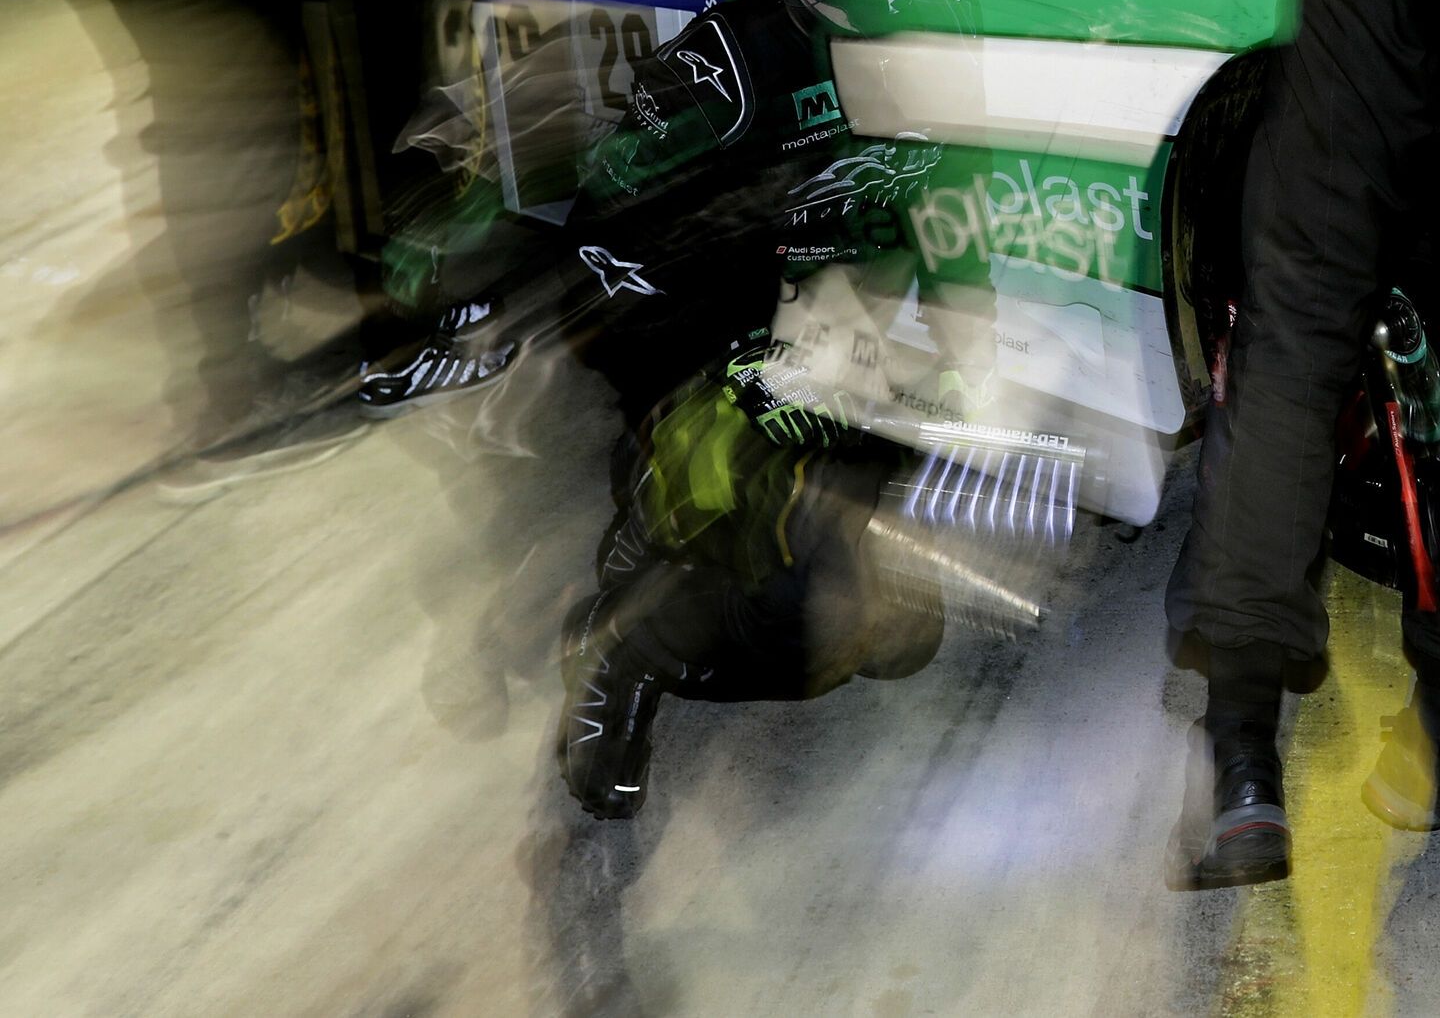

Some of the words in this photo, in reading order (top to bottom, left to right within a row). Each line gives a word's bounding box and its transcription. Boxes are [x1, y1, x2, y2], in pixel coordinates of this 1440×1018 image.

[782, 118, 861, 151] montaplast
[788, 246, 808, 254] Audi
[810, 245, 835, 256] Sport
[787, 254, 829, 262] customer
